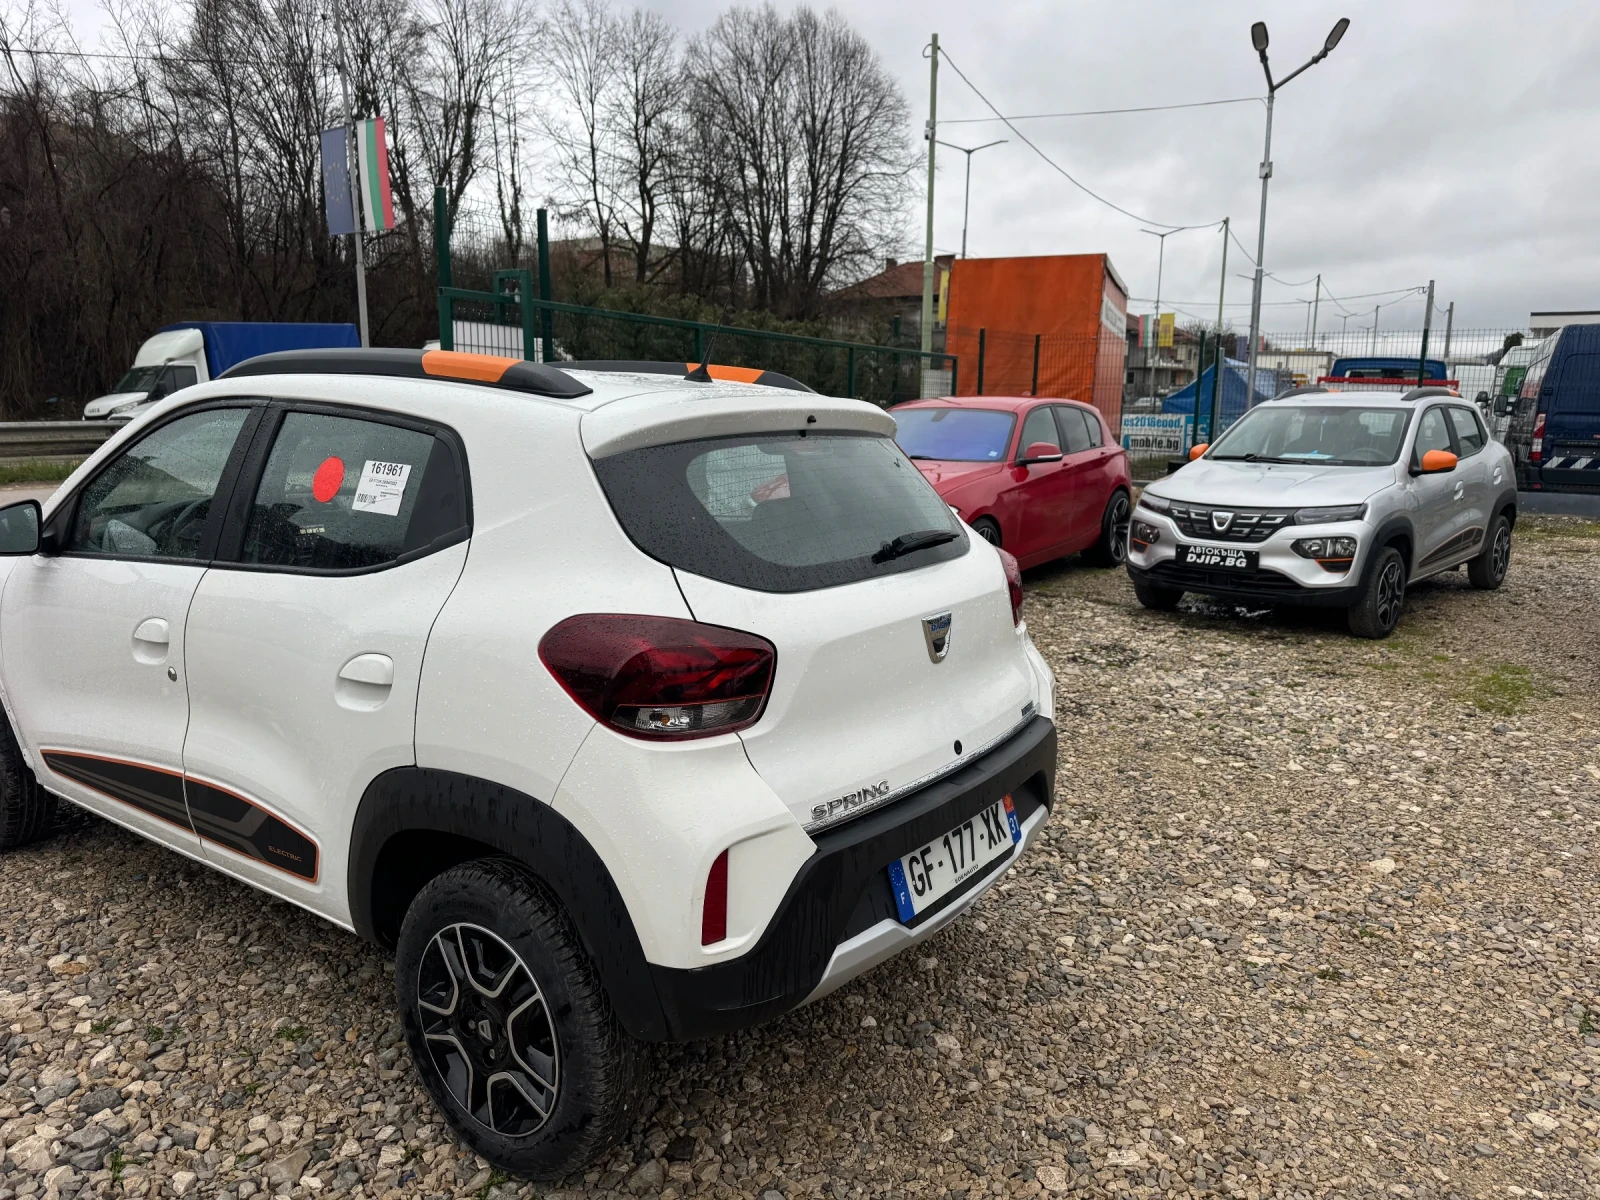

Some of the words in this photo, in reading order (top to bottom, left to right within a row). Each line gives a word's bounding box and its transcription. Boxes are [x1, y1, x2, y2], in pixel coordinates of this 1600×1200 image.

[1131, 437, 1179, 451] mobile.bg
[371, 462, 404, 477] 161961
[1188, 546, 1245, 558] АВТОКЪЩА
[1186, 553, 1248, 568] DJIP.BG
[811, 779, 889, 820] SPRING
[1008, 815, 1020, 834] 31
[268, 845, 302, 862] ELECTRIC
[908, 802, 1007, 897] GF-177-XK
[954, 863, 979, 884] EDENAUTO
[900, 891, 906, 905] F
